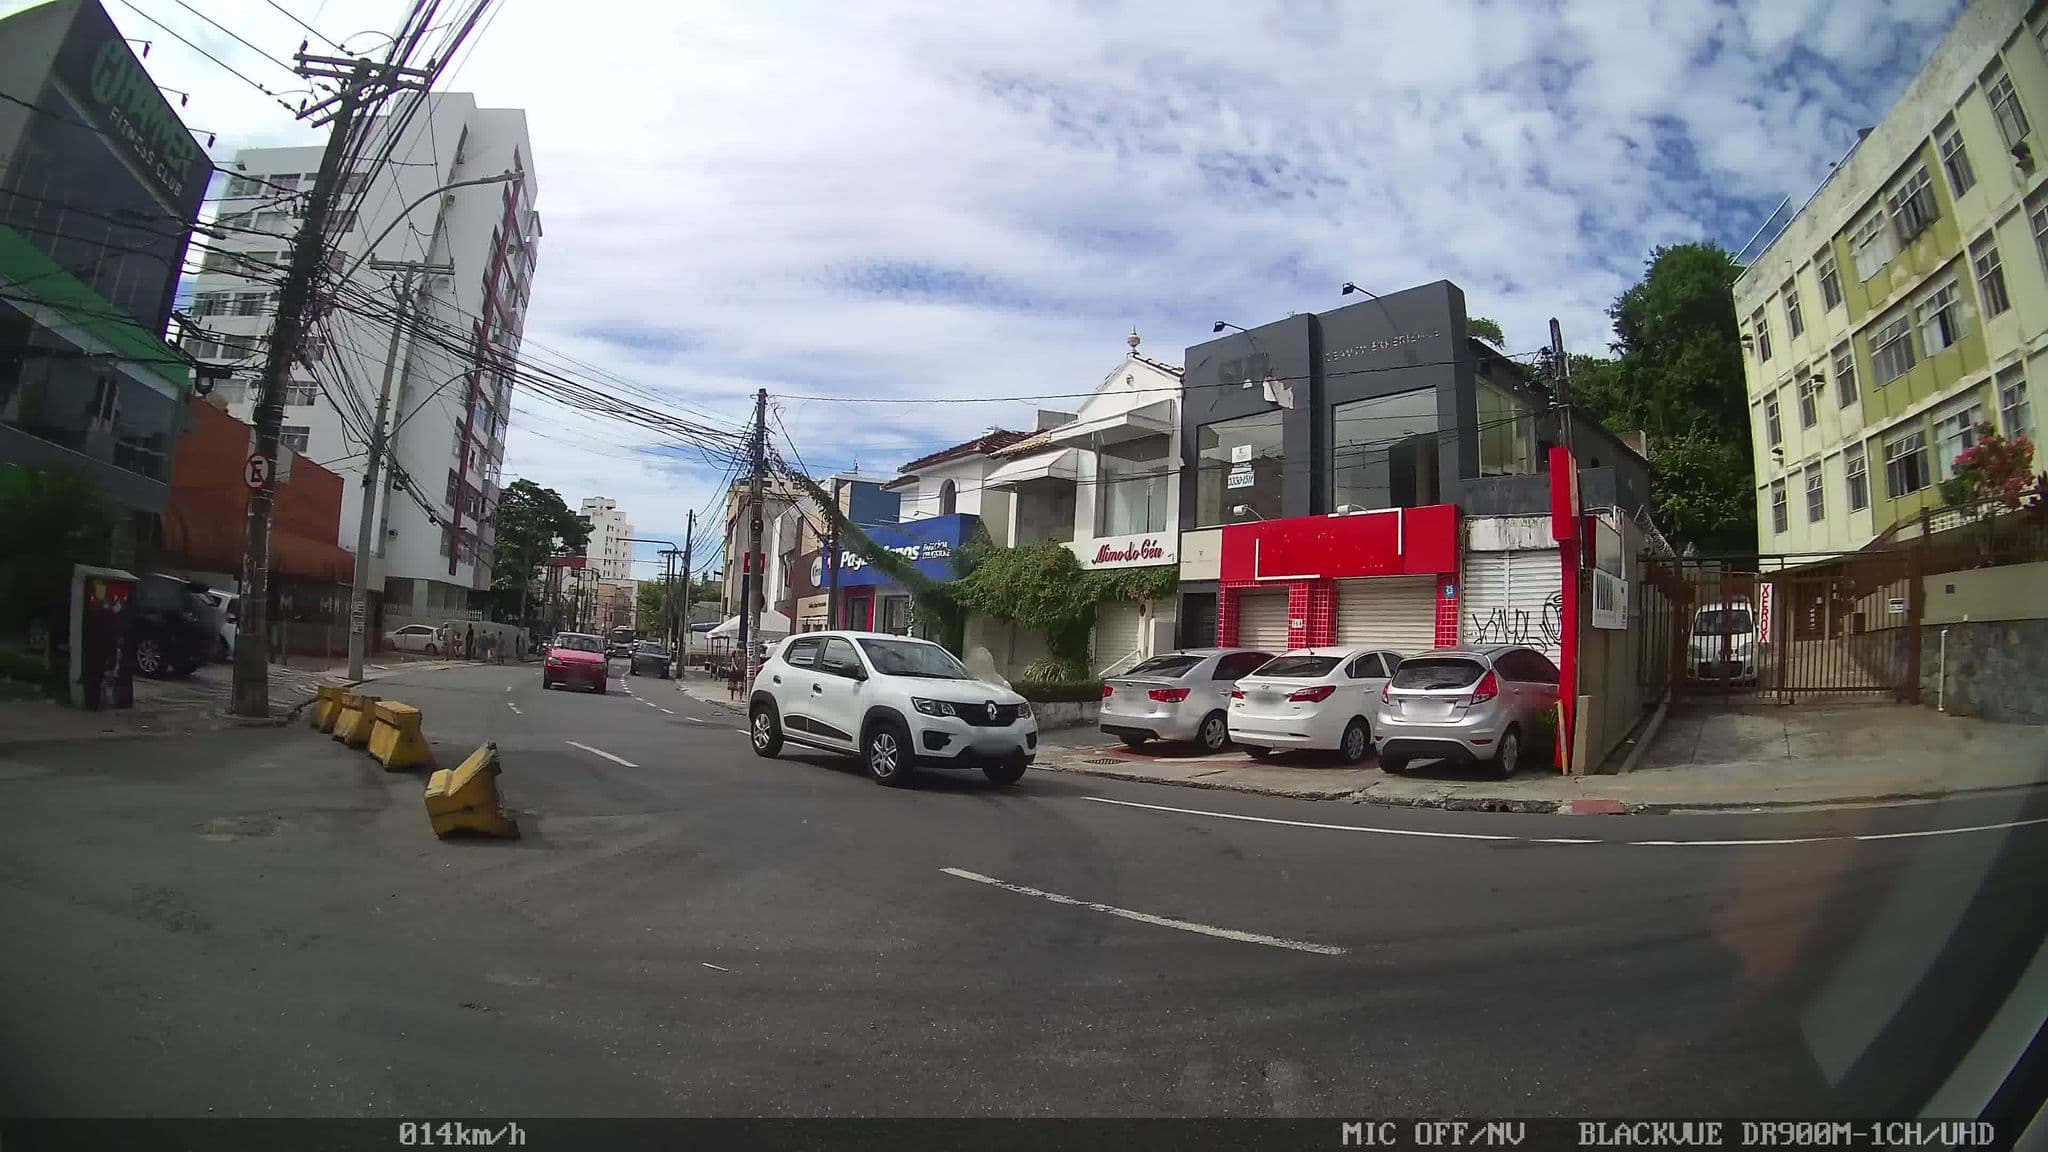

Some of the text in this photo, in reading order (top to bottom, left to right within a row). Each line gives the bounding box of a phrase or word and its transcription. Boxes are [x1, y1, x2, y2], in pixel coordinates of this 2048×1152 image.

[109, 105, 183, 197] FITNESS CLUB
[883, 545, 920, 561] nos
[1760, 584, 1770, 643] XEROX
